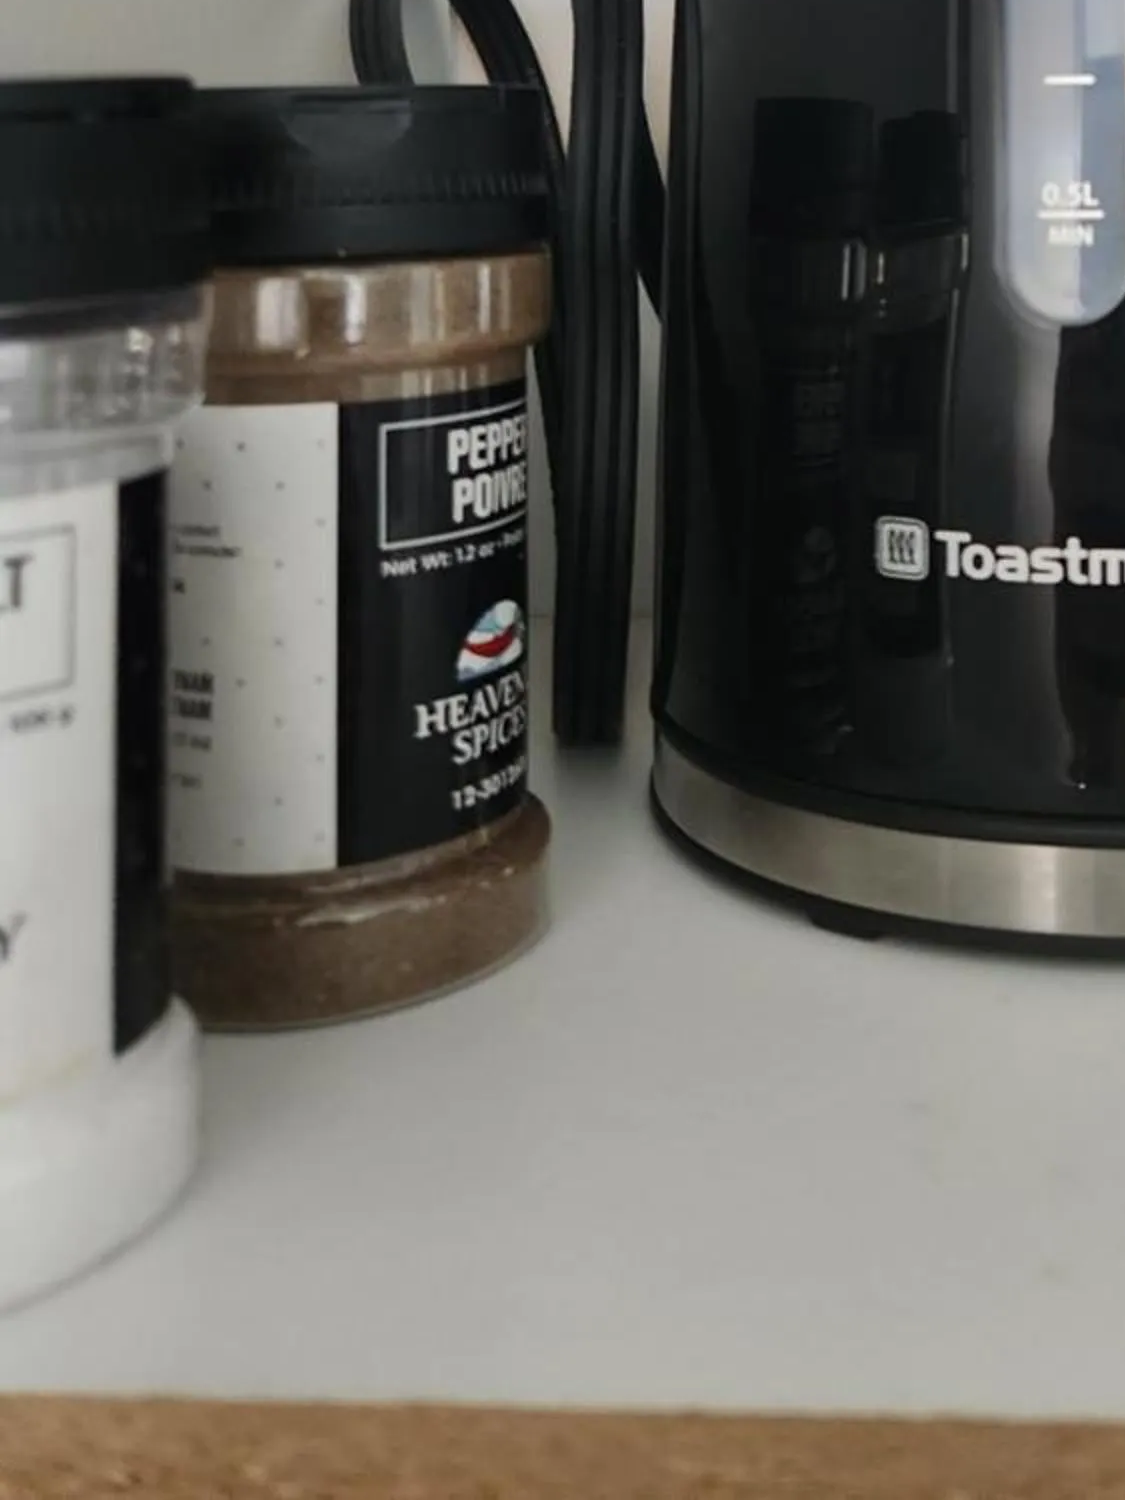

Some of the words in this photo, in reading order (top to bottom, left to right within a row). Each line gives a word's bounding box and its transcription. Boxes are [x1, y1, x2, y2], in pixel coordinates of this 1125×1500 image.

[1041, 180, 1099, 207] 0.5L
[1047, 223, 1095, 247] MIN
[452, 703, 526, 766] SPICE
